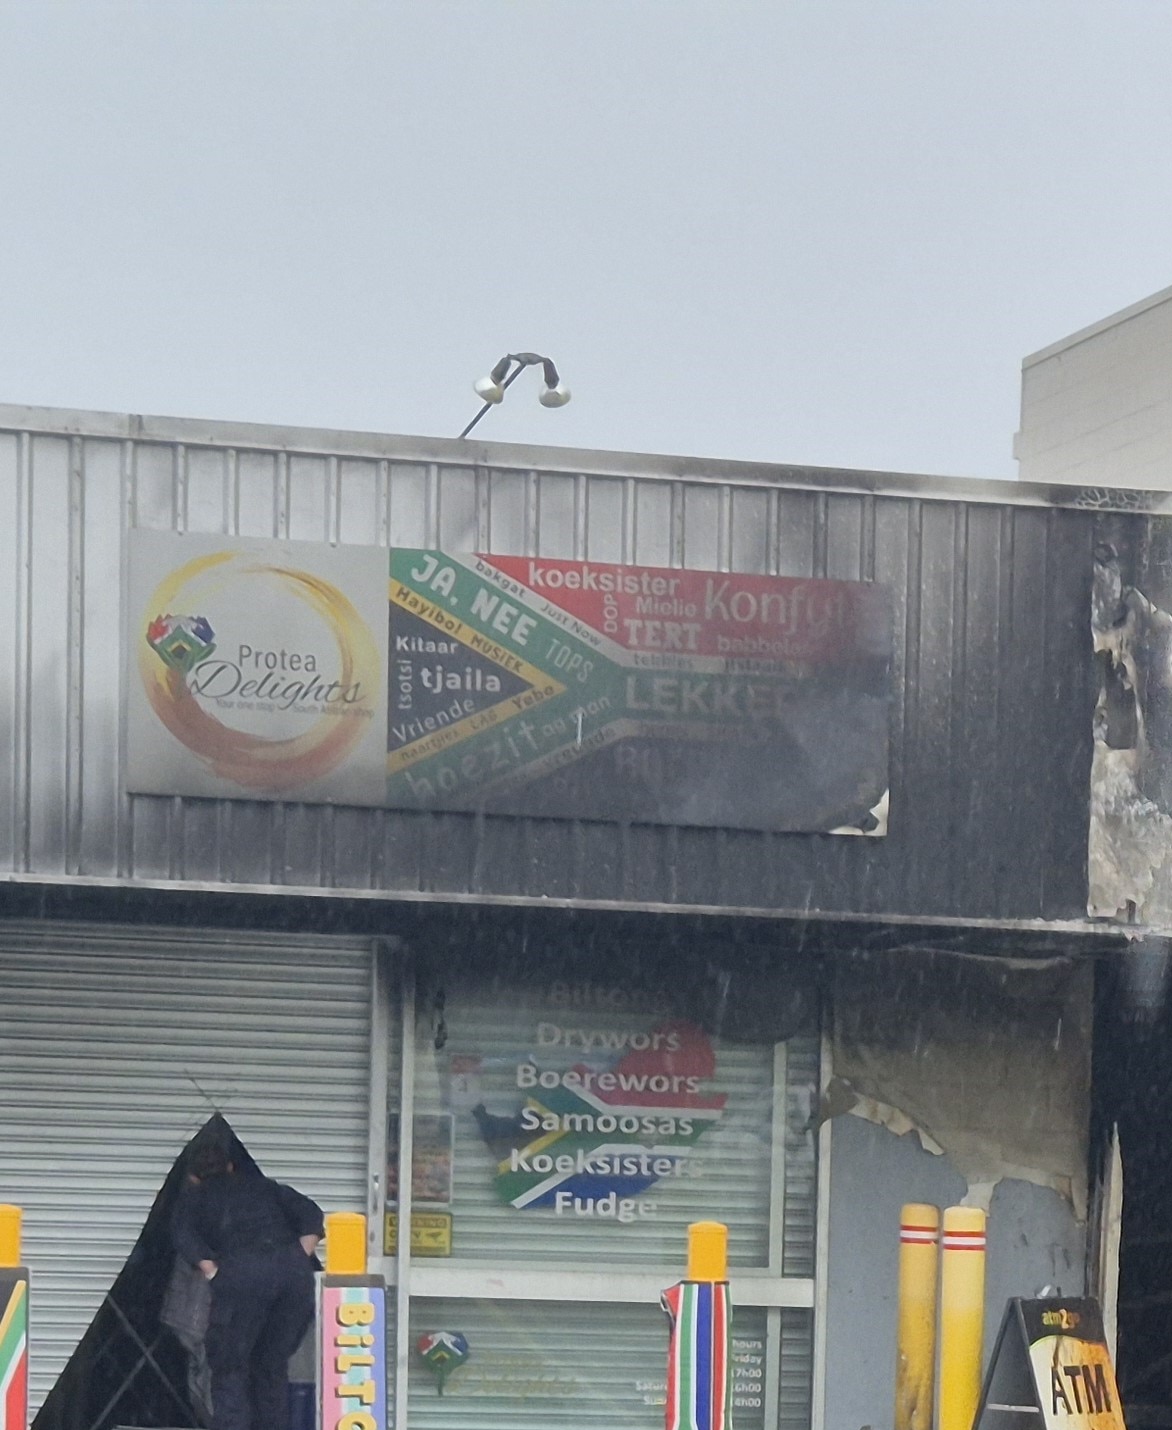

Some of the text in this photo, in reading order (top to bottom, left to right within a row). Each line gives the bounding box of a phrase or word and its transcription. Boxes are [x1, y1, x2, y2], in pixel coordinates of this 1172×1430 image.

[528, 561, 681, 597] koeksister
[470, 588, 539, 647] NEE
[475, 560, 601, 647] bakgat Just Now
[603, 594, 619, 633] DOP
[396, 635, 459, 655] Kitaar
[623, 618, 702, 650] TERT
[238, 644, 317, 672] Protea
[545, 638, 594, 683] TOPS
[190, 659, 367, 711] Delights
[398, 660, 413, 710] tsotsi
[420, 665, 501, 695] tjaila
[392, 698, 476, 743] Vriende
[536, 1021, 681, 1053] Drywors
[516, 1063, 701, 1094] Boerewors
[520, 1106, 694, 1136] Samoosas
[510, 1147, 704, 1178] Koeksisters
[554, 1190, 658, 1223] Fudge
[733, 1354, 763, 1365] riday
[733, 1368, 763, 1379] 7h00
[733, 1382, 762, 1393] 6h00
[1050, 1363, 1112, 1416] ATM
